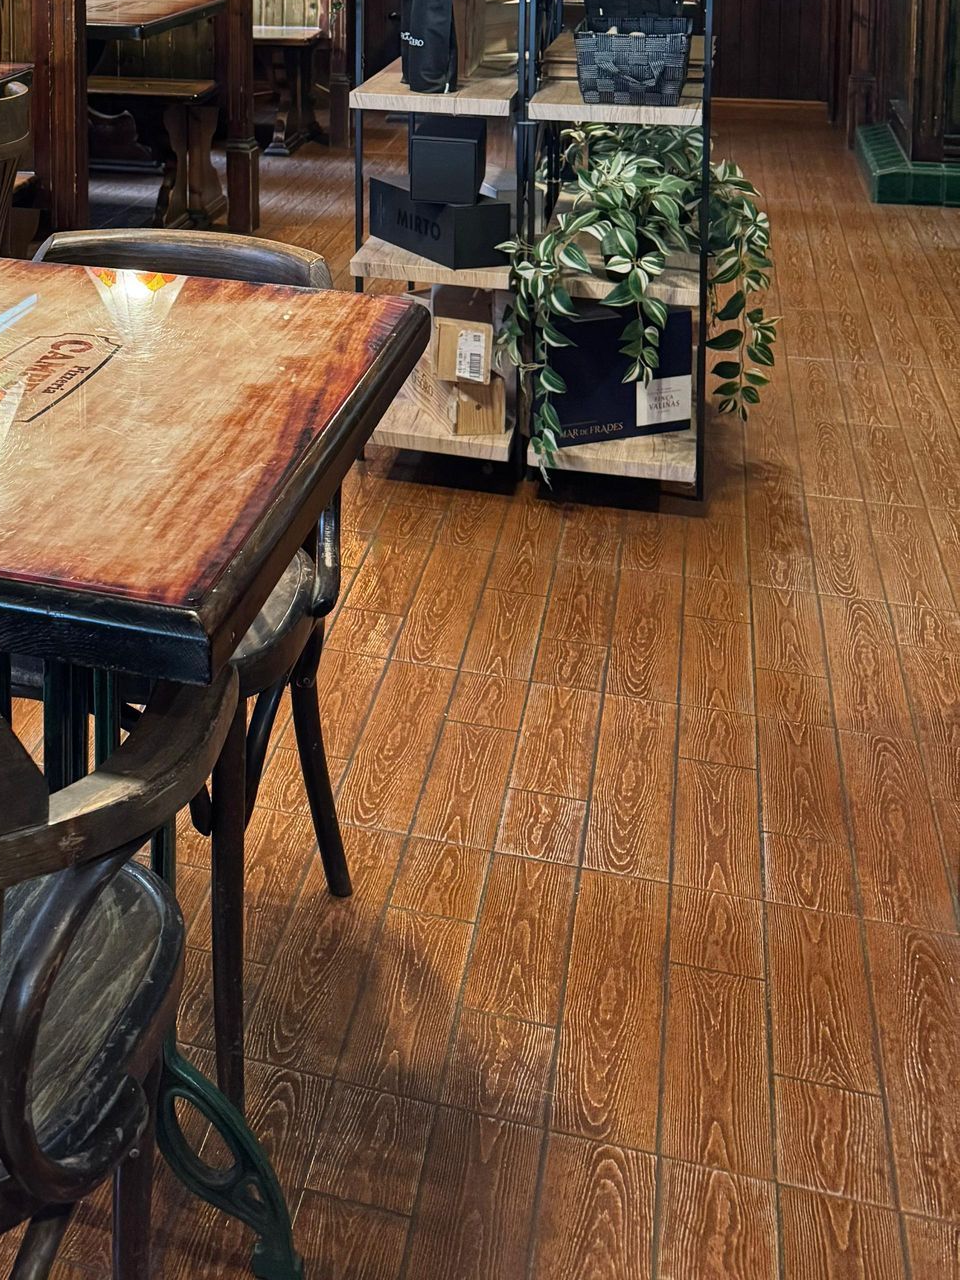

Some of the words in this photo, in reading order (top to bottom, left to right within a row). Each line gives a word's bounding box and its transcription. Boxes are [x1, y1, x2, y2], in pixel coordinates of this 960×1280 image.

[397, 207, 441, 241] MIRTO
[41, 365, 91, 394] Pizzeria
[590, 422, 624, 434] FRADES
